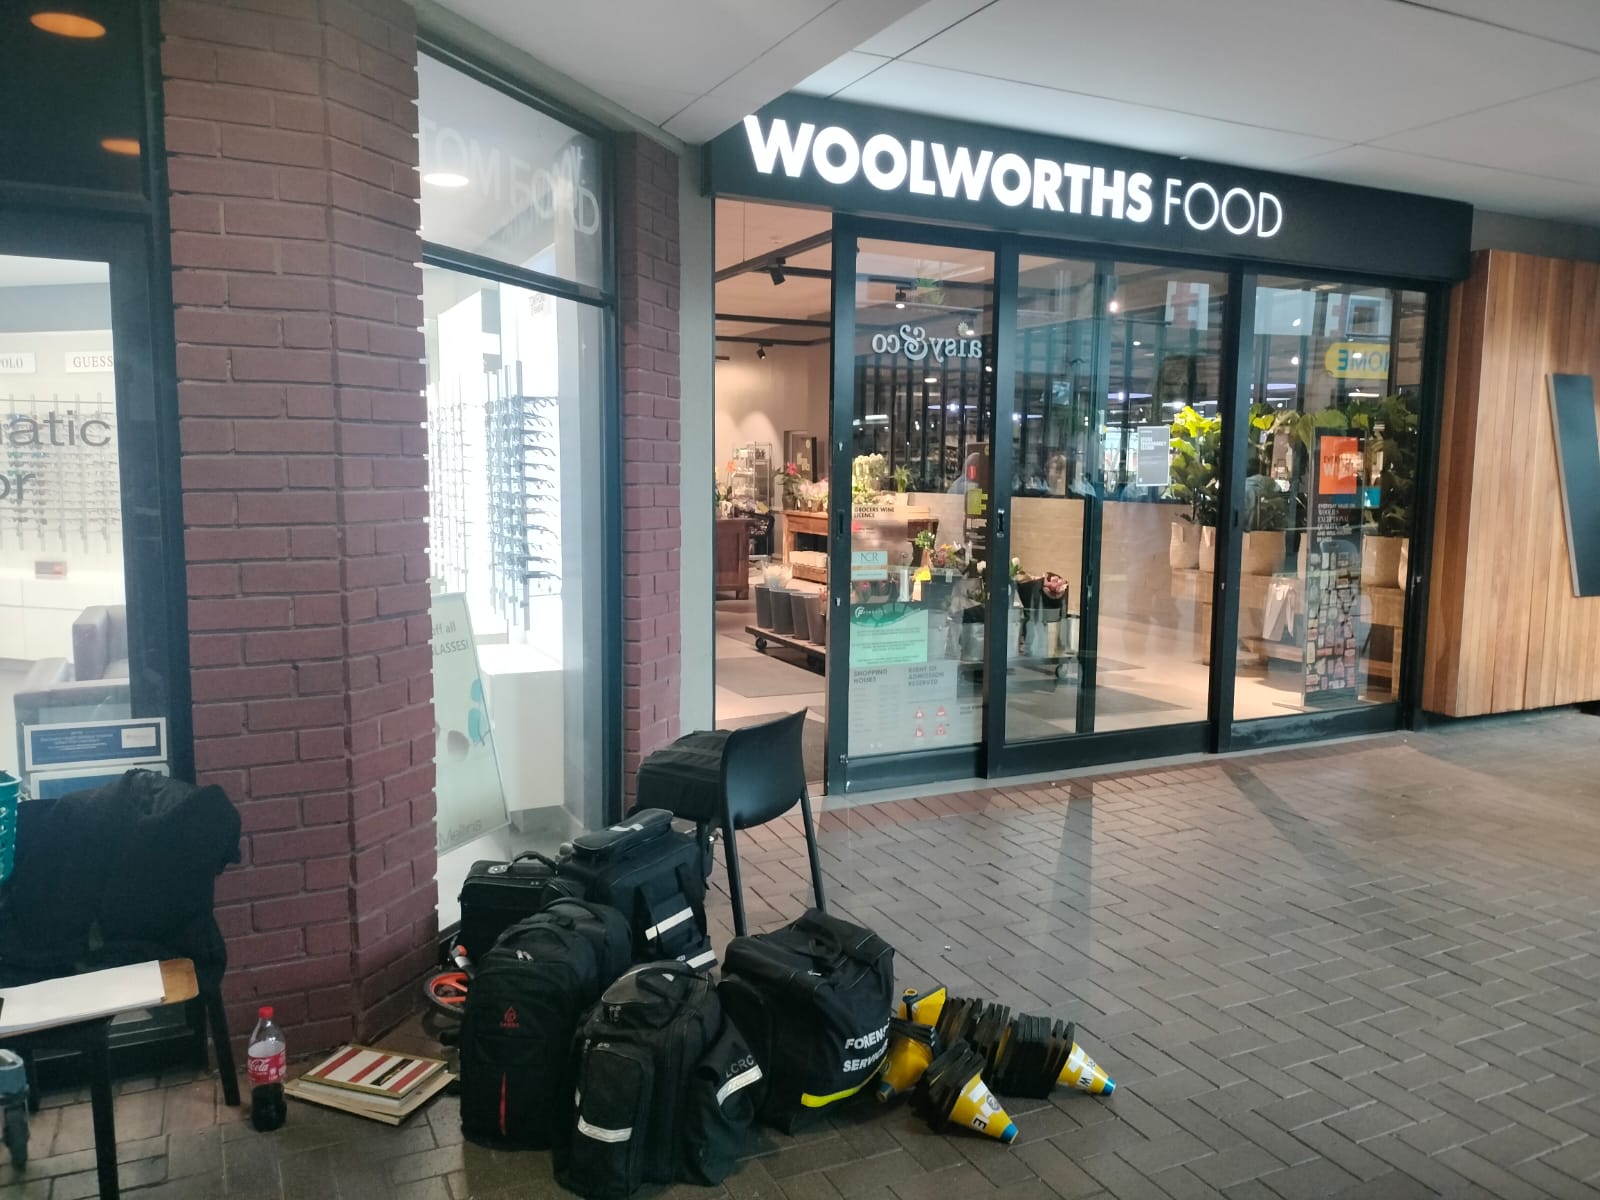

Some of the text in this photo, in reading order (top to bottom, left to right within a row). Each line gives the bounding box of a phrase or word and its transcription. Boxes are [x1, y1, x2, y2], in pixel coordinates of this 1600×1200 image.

[743, 114, 1283, 239] WOOLWORTHS FOOD
[73, 354, 113, 369] GUESS
[0, 409, 112, 448] atic
[972, 1116, 988, 1131] E
